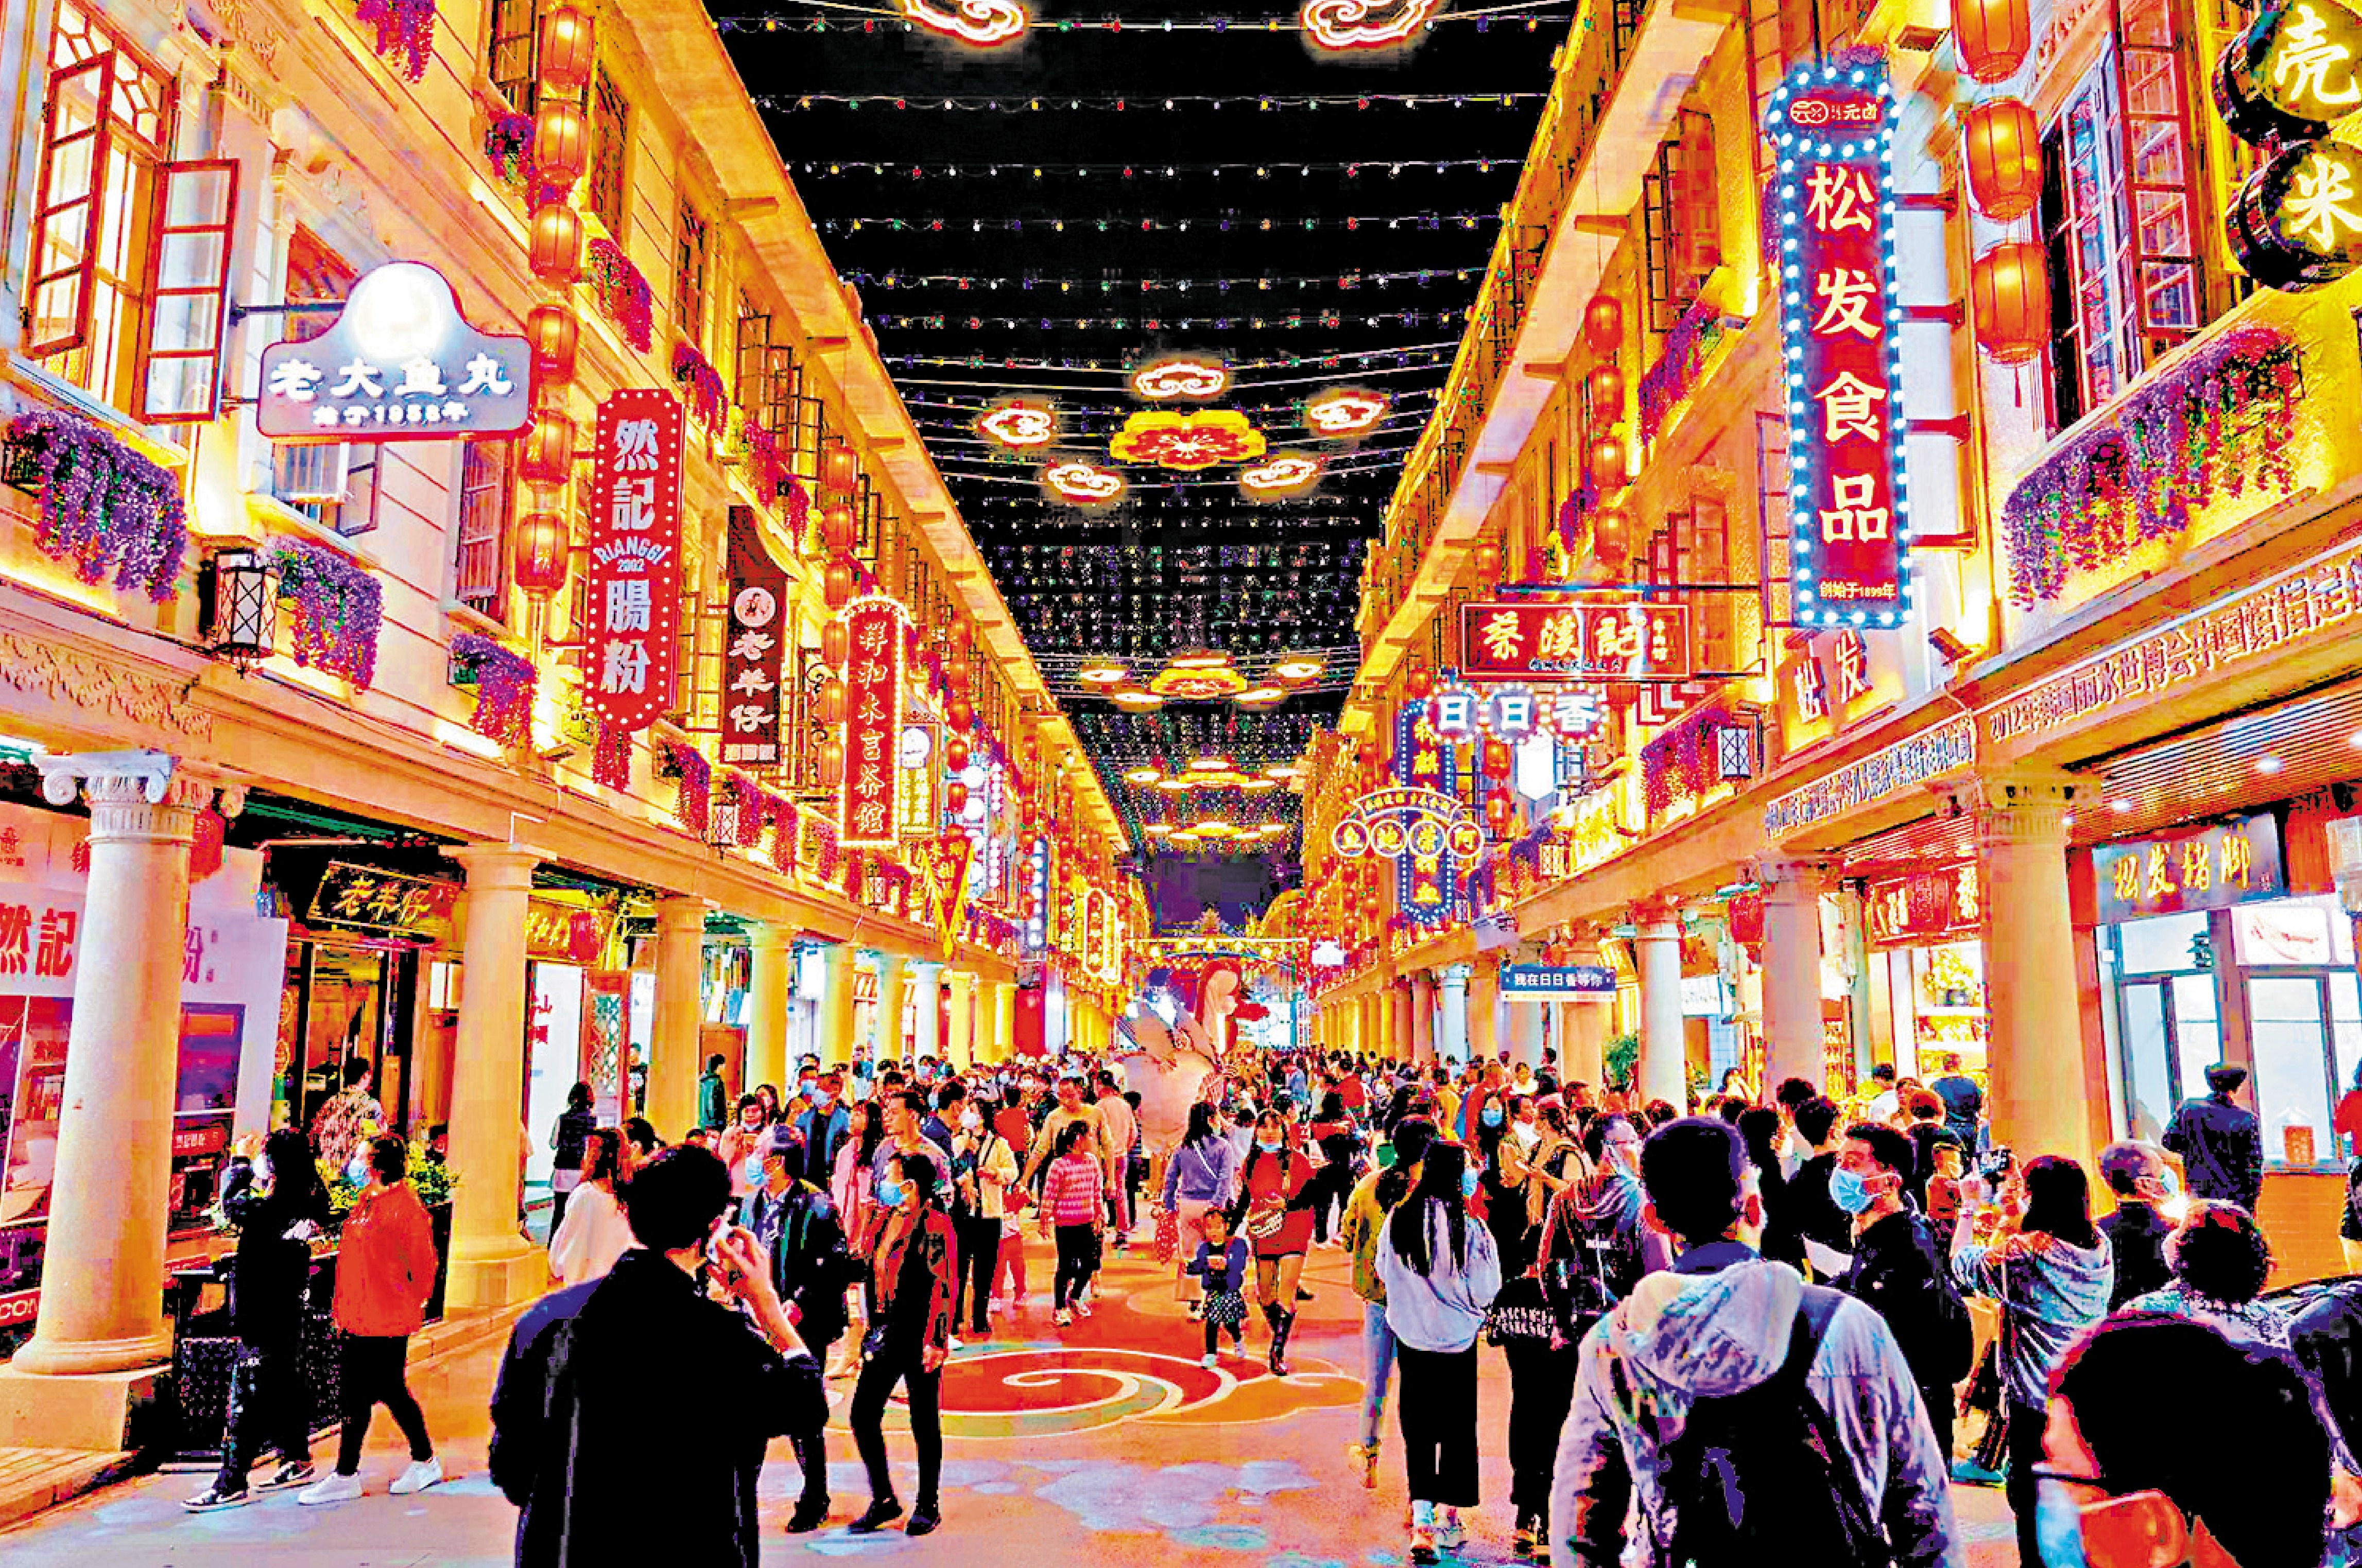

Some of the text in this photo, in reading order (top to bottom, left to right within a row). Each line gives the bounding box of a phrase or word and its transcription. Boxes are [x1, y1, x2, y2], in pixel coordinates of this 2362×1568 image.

[269, 354, 514, 400] 老大鱼丸
[1806, 165, 1887, 544] 松发食品
[611, 419, 660, 531] 然記
[1820, 581, 1896, 600] 创始于1899年
[1439, 696, 1600, 732] 日日香
